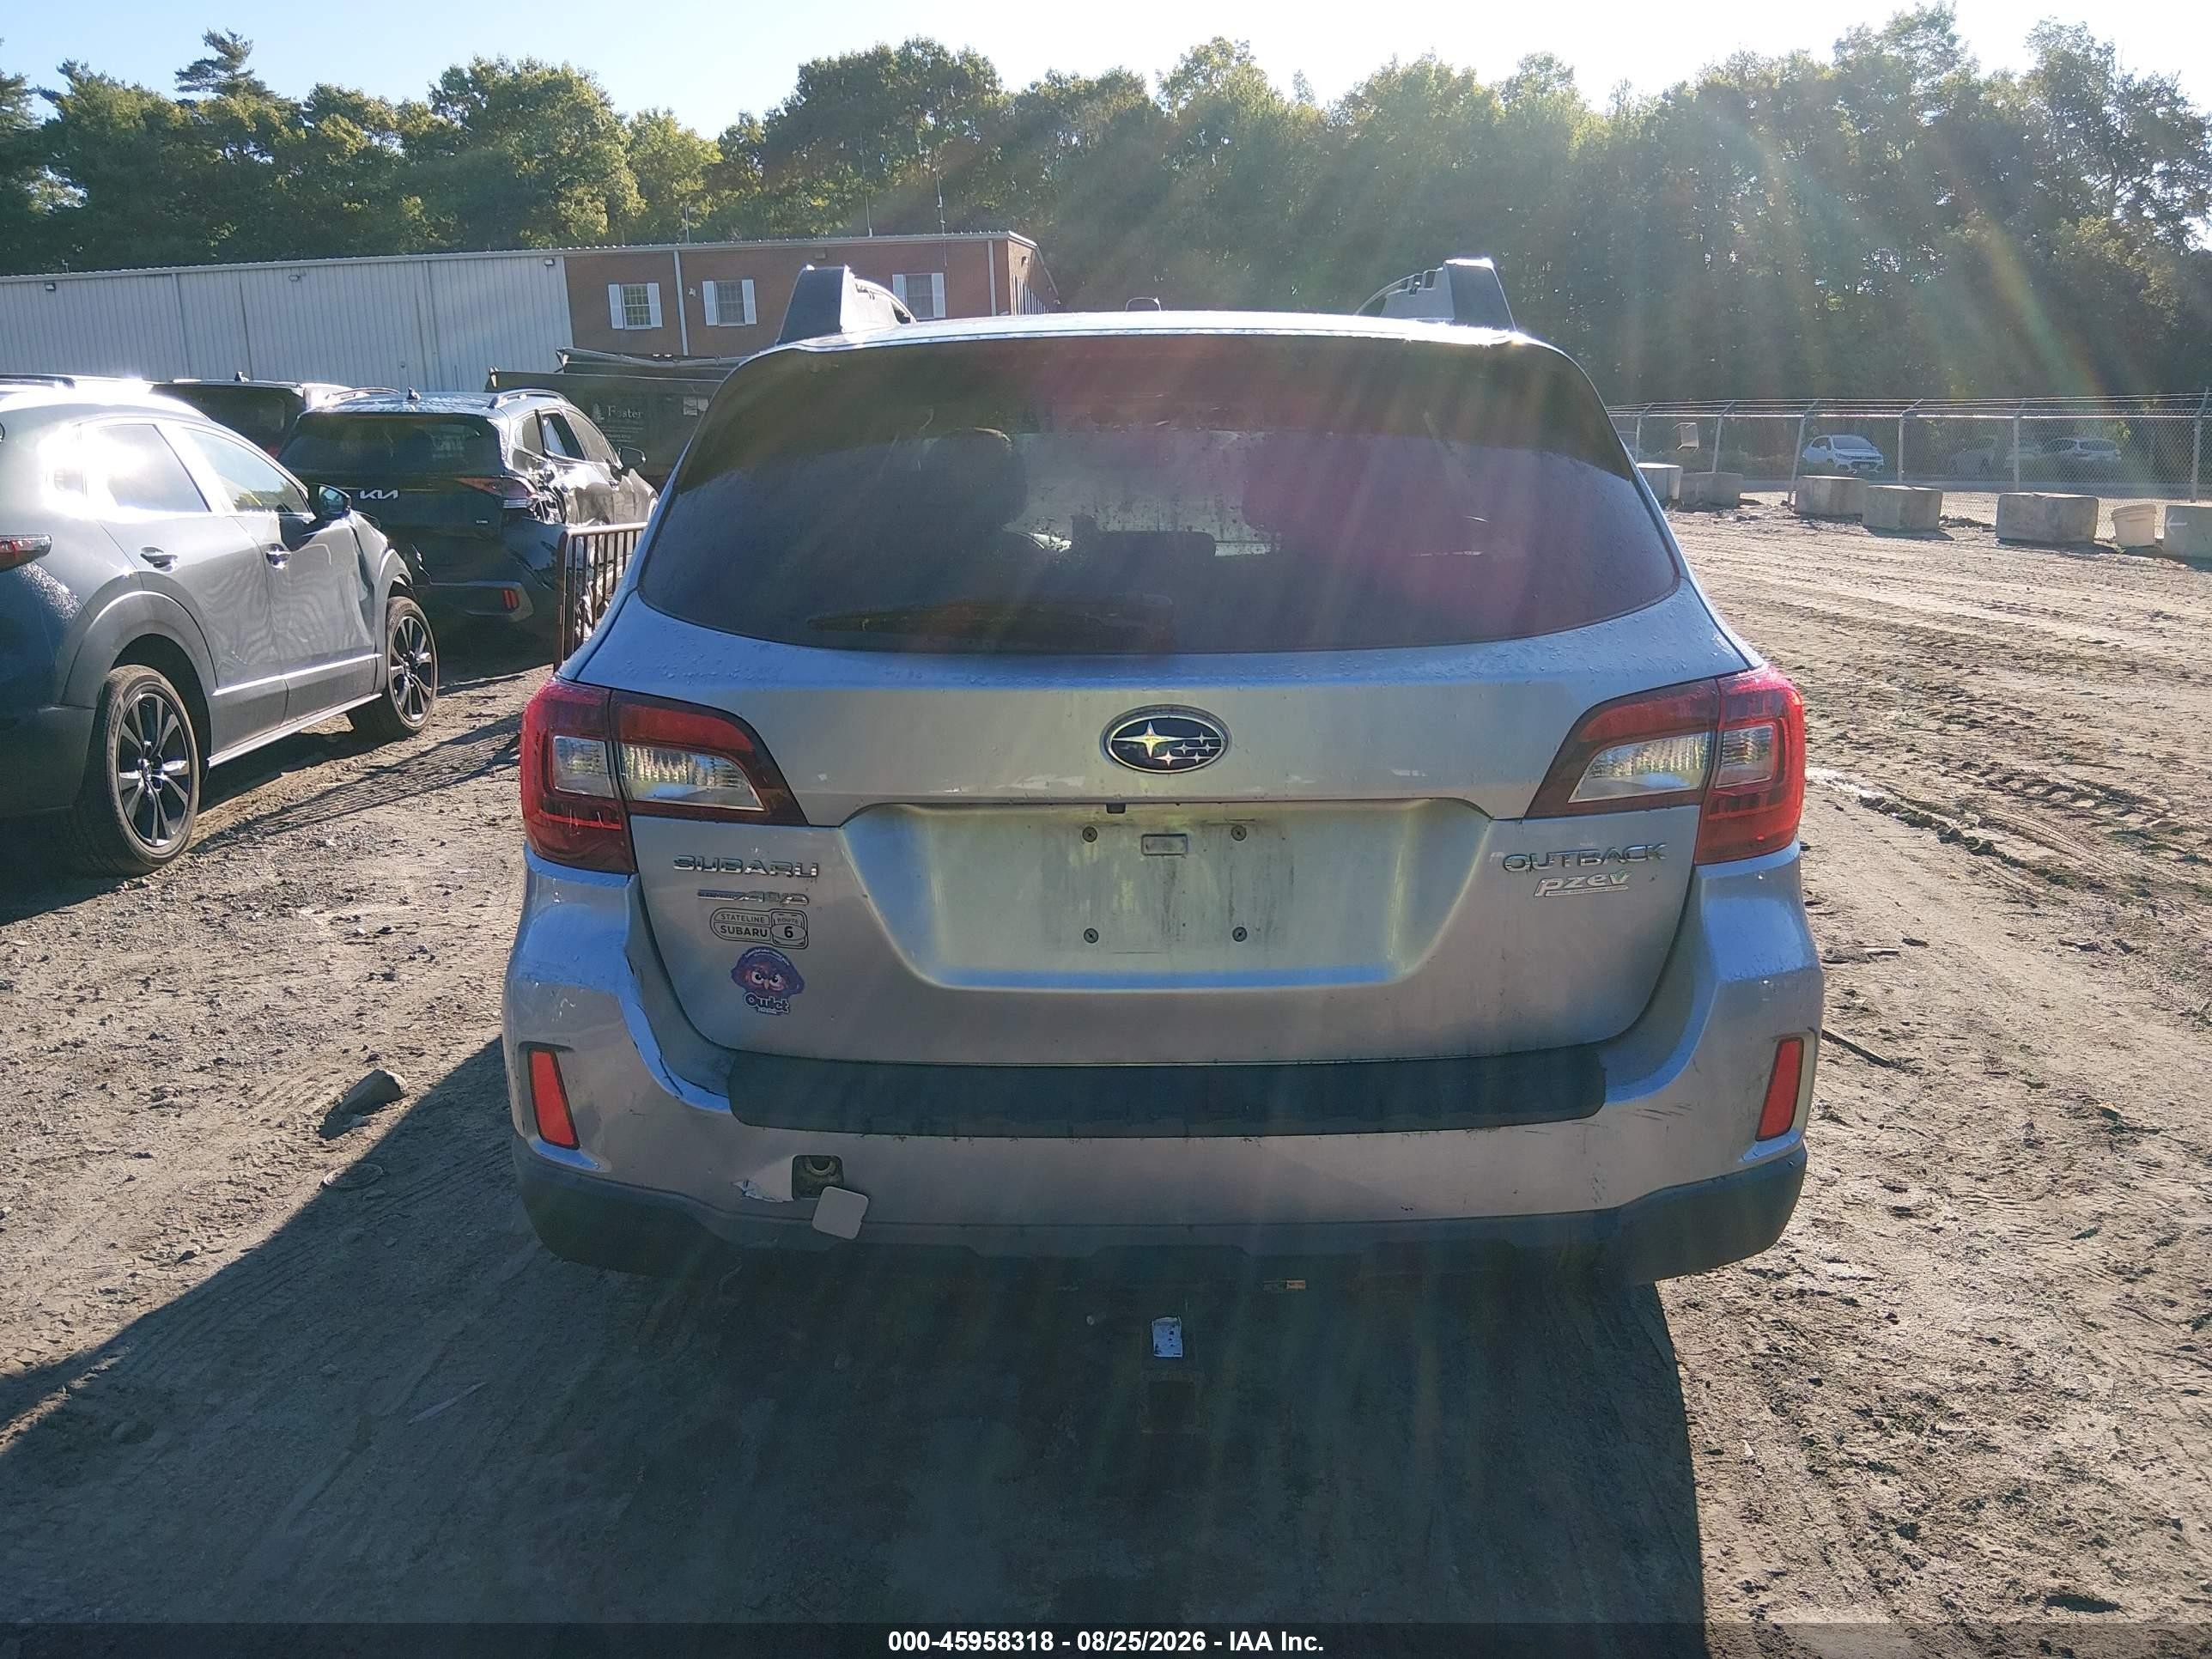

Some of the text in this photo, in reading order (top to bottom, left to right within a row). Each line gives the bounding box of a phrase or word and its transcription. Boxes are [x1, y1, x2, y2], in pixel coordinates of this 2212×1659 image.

[1503, 842, 1668, 873] OUTBACK
[673, 855, 819, 878] SUBARU
[720, 914, 765, 924] STATELINE
[720, 925, 769, 938] SUBARU
[784, 926, 794, 939] 6
